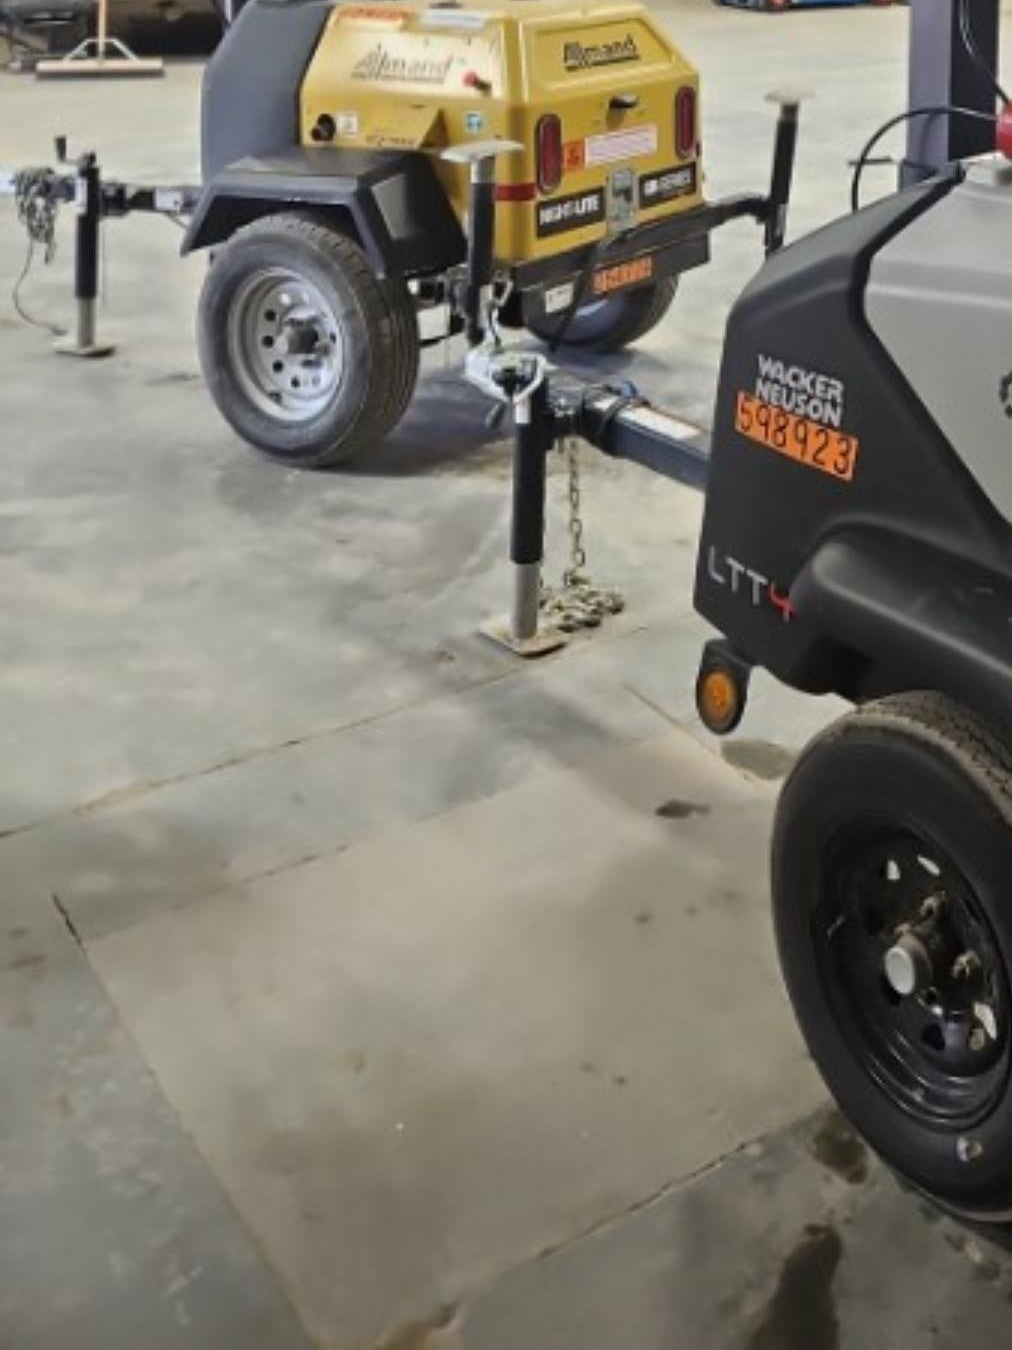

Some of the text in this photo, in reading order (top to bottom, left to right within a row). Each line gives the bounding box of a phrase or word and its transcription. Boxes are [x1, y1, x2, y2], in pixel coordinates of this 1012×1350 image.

[755, 378, 842, 428] NEUSON
[758, 354, 845, 403] WACKER
[739, 402, 851, 475] 598923
[708, 545, 792, 623] LTT4
